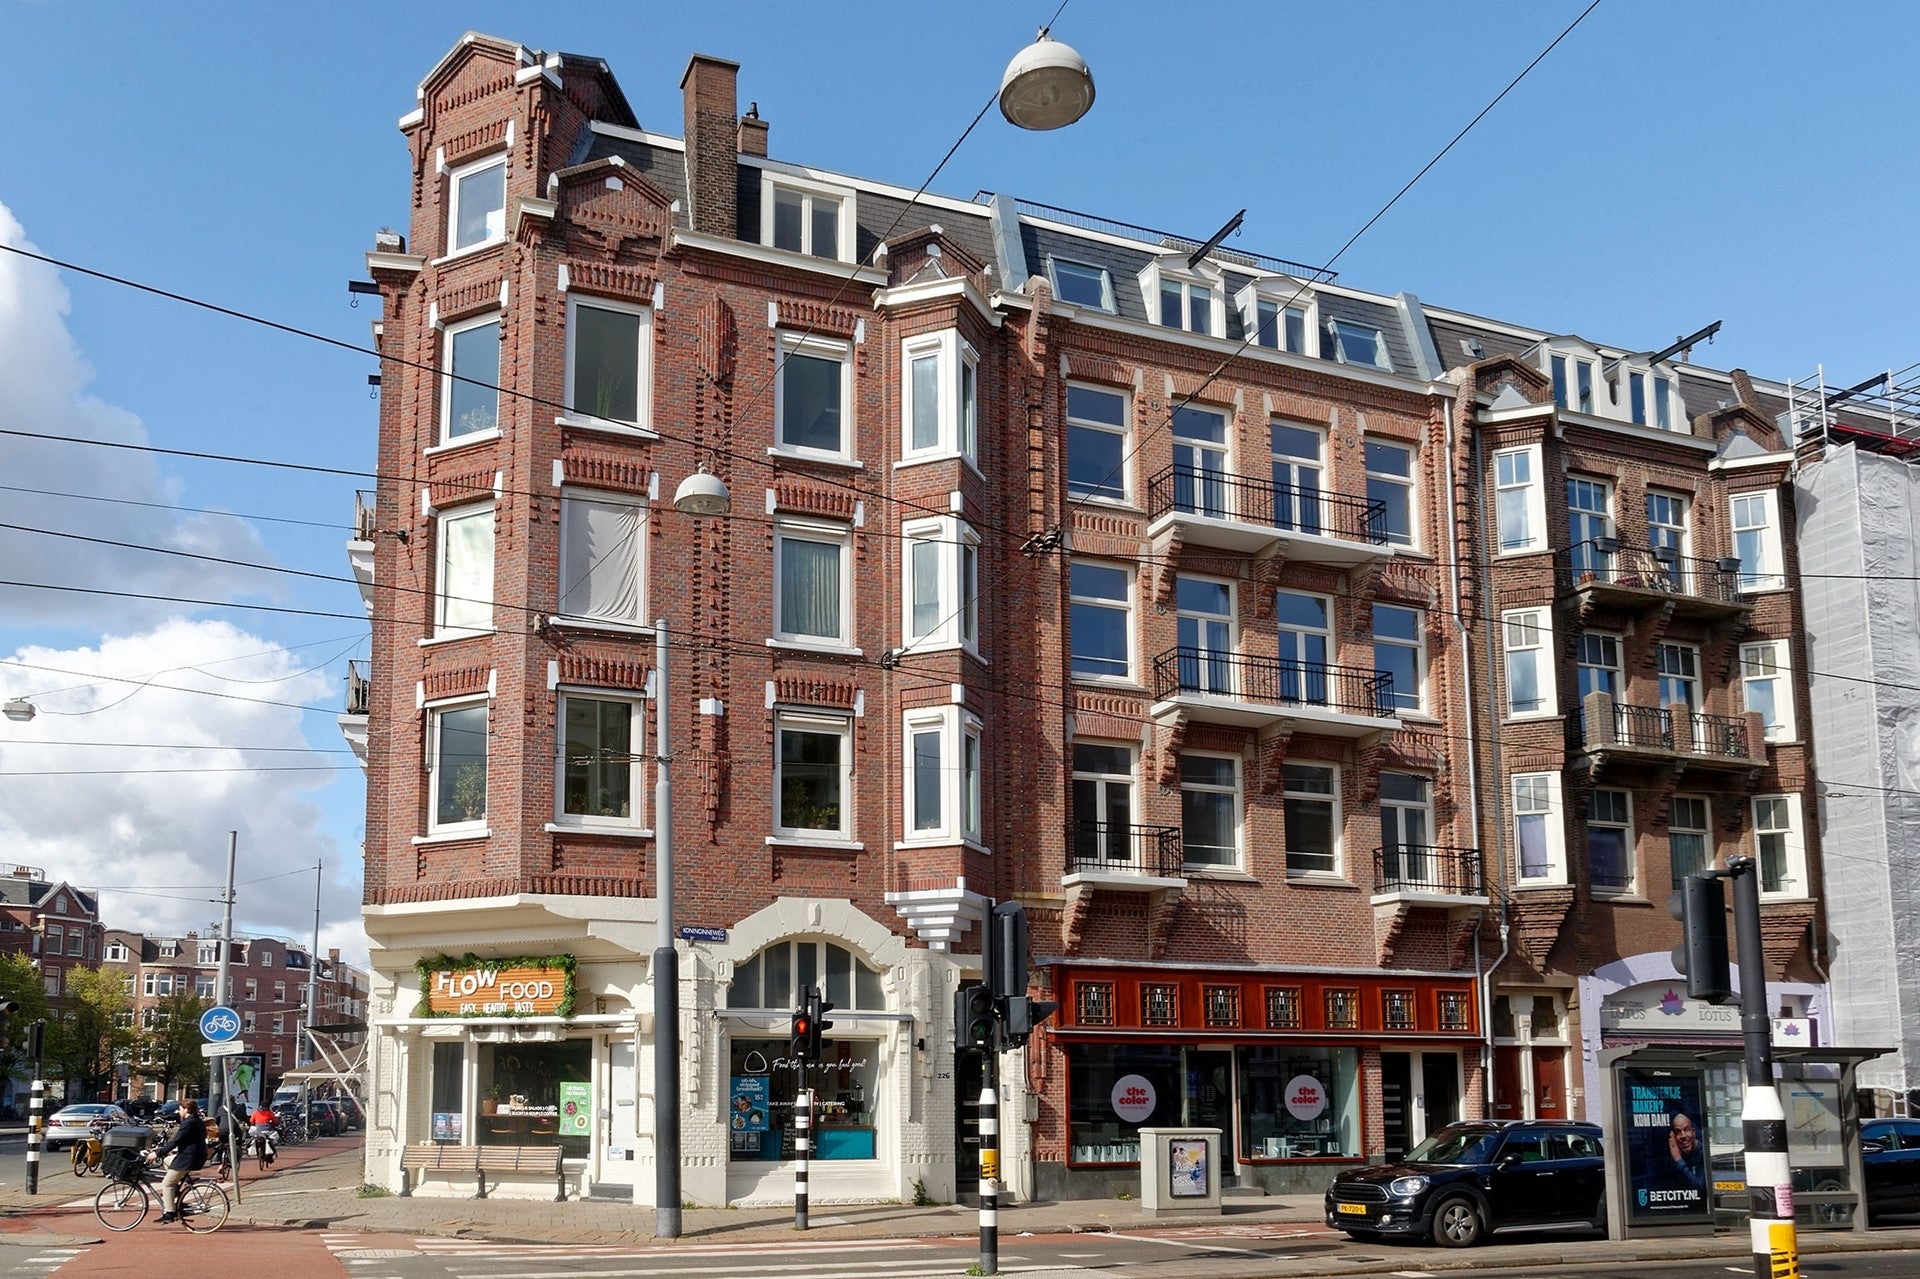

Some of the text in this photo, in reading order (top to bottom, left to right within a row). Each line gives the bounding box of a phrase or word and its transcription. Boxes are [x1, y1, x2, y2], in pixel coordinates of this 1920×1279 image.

[682, 927, 725, 937] KONINGINNEWEG
[438, 969, 554, 1000] FLOW FOOD
[1610, 1008, 1646, 1019] LOTUS
[1698, 1011, 1732, 1021] LOTUS
[772, 1057, 789, 1071] Food
[838, 1058, 851, 1070] feel
[937, 1072, 950, 1080] 226
[1126, 1086, 1147, 1096] the
[1298, 1086, 1317, 1095] the
[1631, 1086, 1682, 1099] TRANSFERTJE
[1118, 1096, 1149, 1105] color
[1291, 1096, 1320, 1104] color
[1632, 1100, 1664, 1113] MAKEN?
[1633, 1114, 1671, 1127] KOM DAN!
[1649, 1189, 1701, 1201] BETCITY.NL
